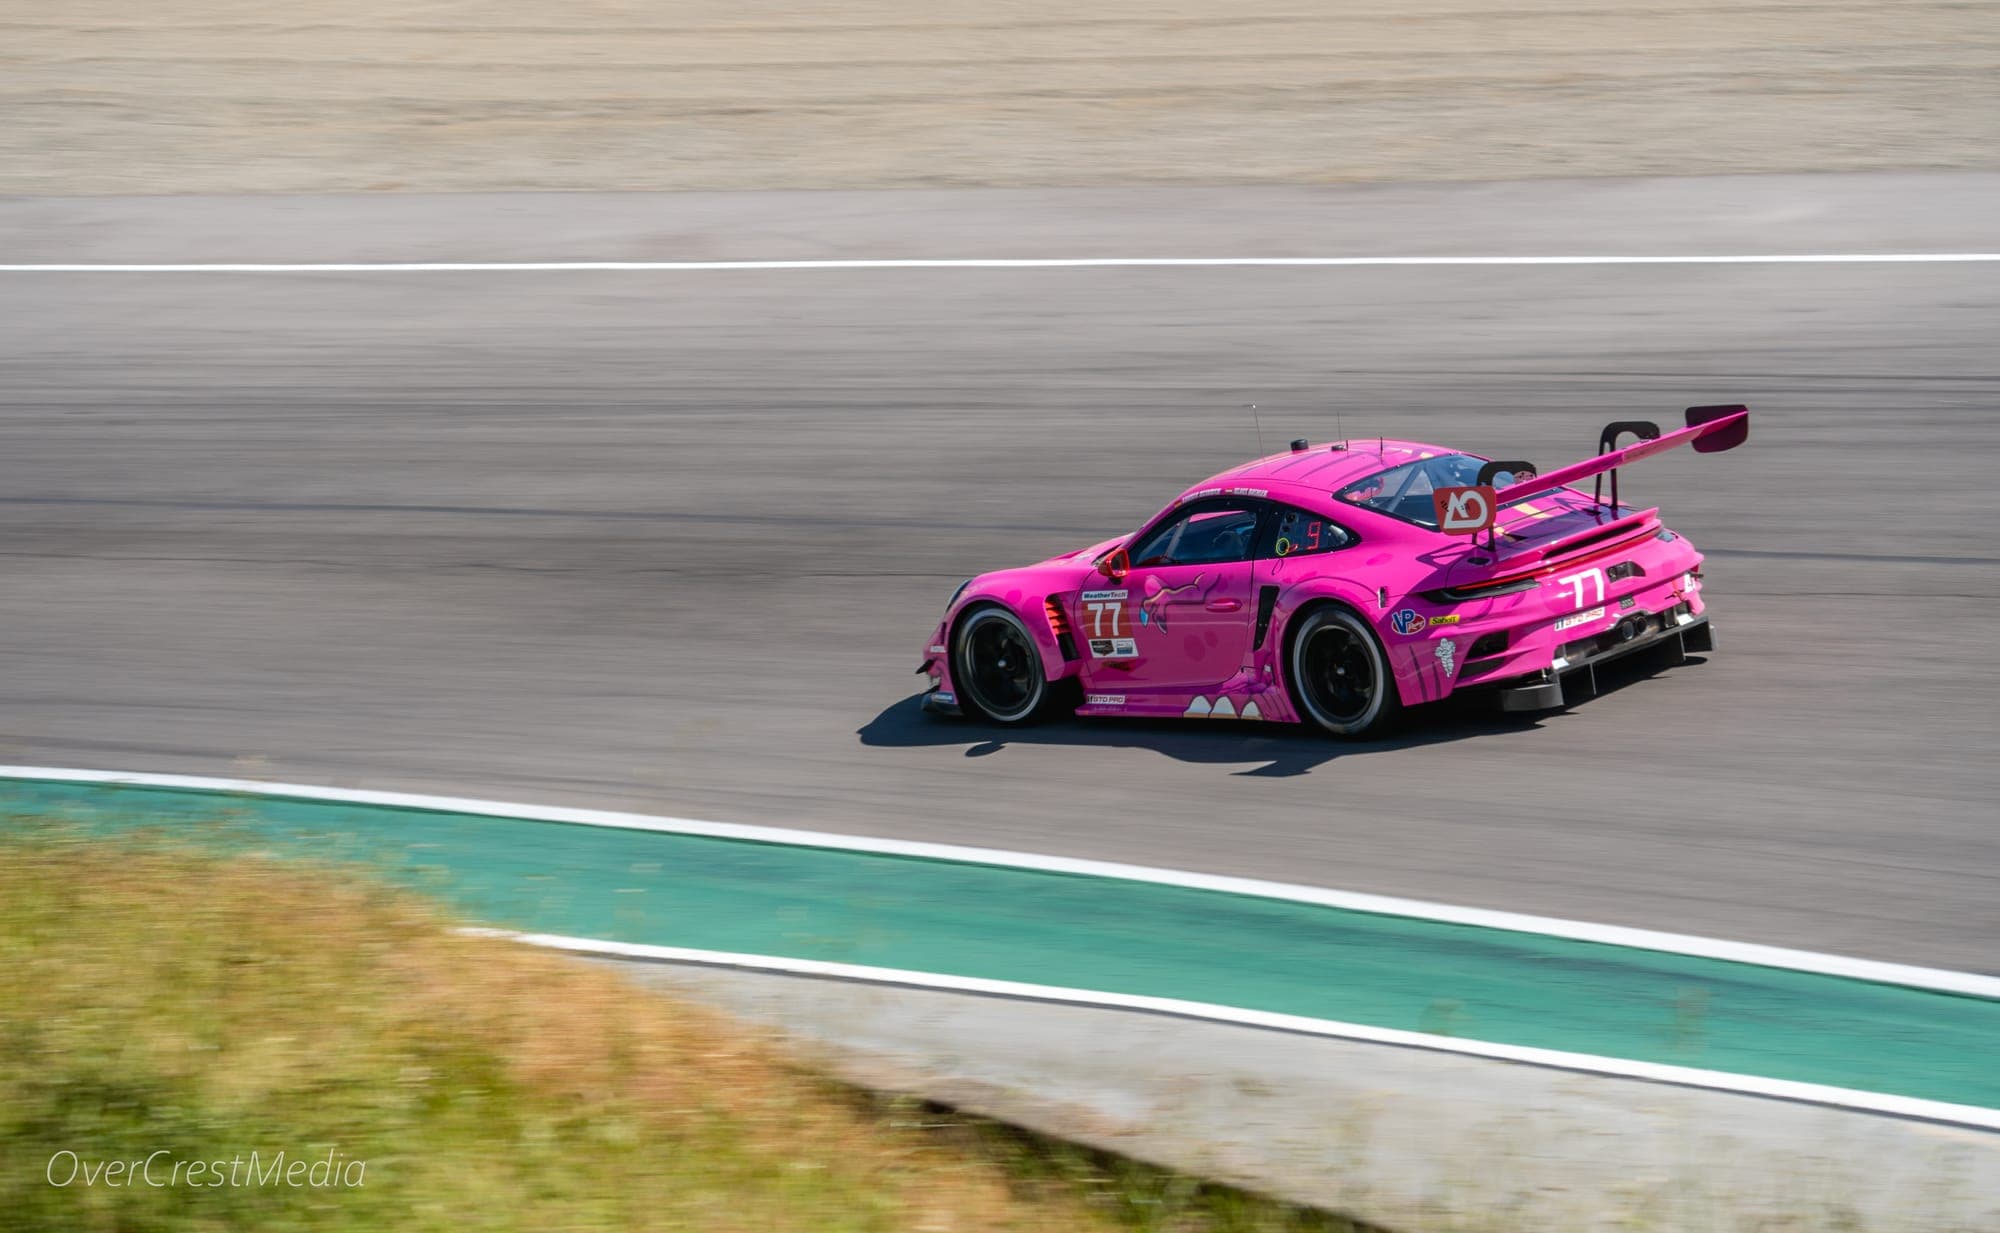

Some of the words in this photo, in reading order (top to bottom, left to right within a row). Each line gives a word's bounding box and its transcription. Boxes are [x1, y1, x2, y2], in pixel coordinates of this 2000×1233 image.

[1307, 521, 1322, 550] 9
[1083, 591, 1127, 599] WeatherTech
[1558, 567, 1605, 609] 77
[1087, 602, 1122, 637] 77
[1392, 609, 1416, 635] VP
